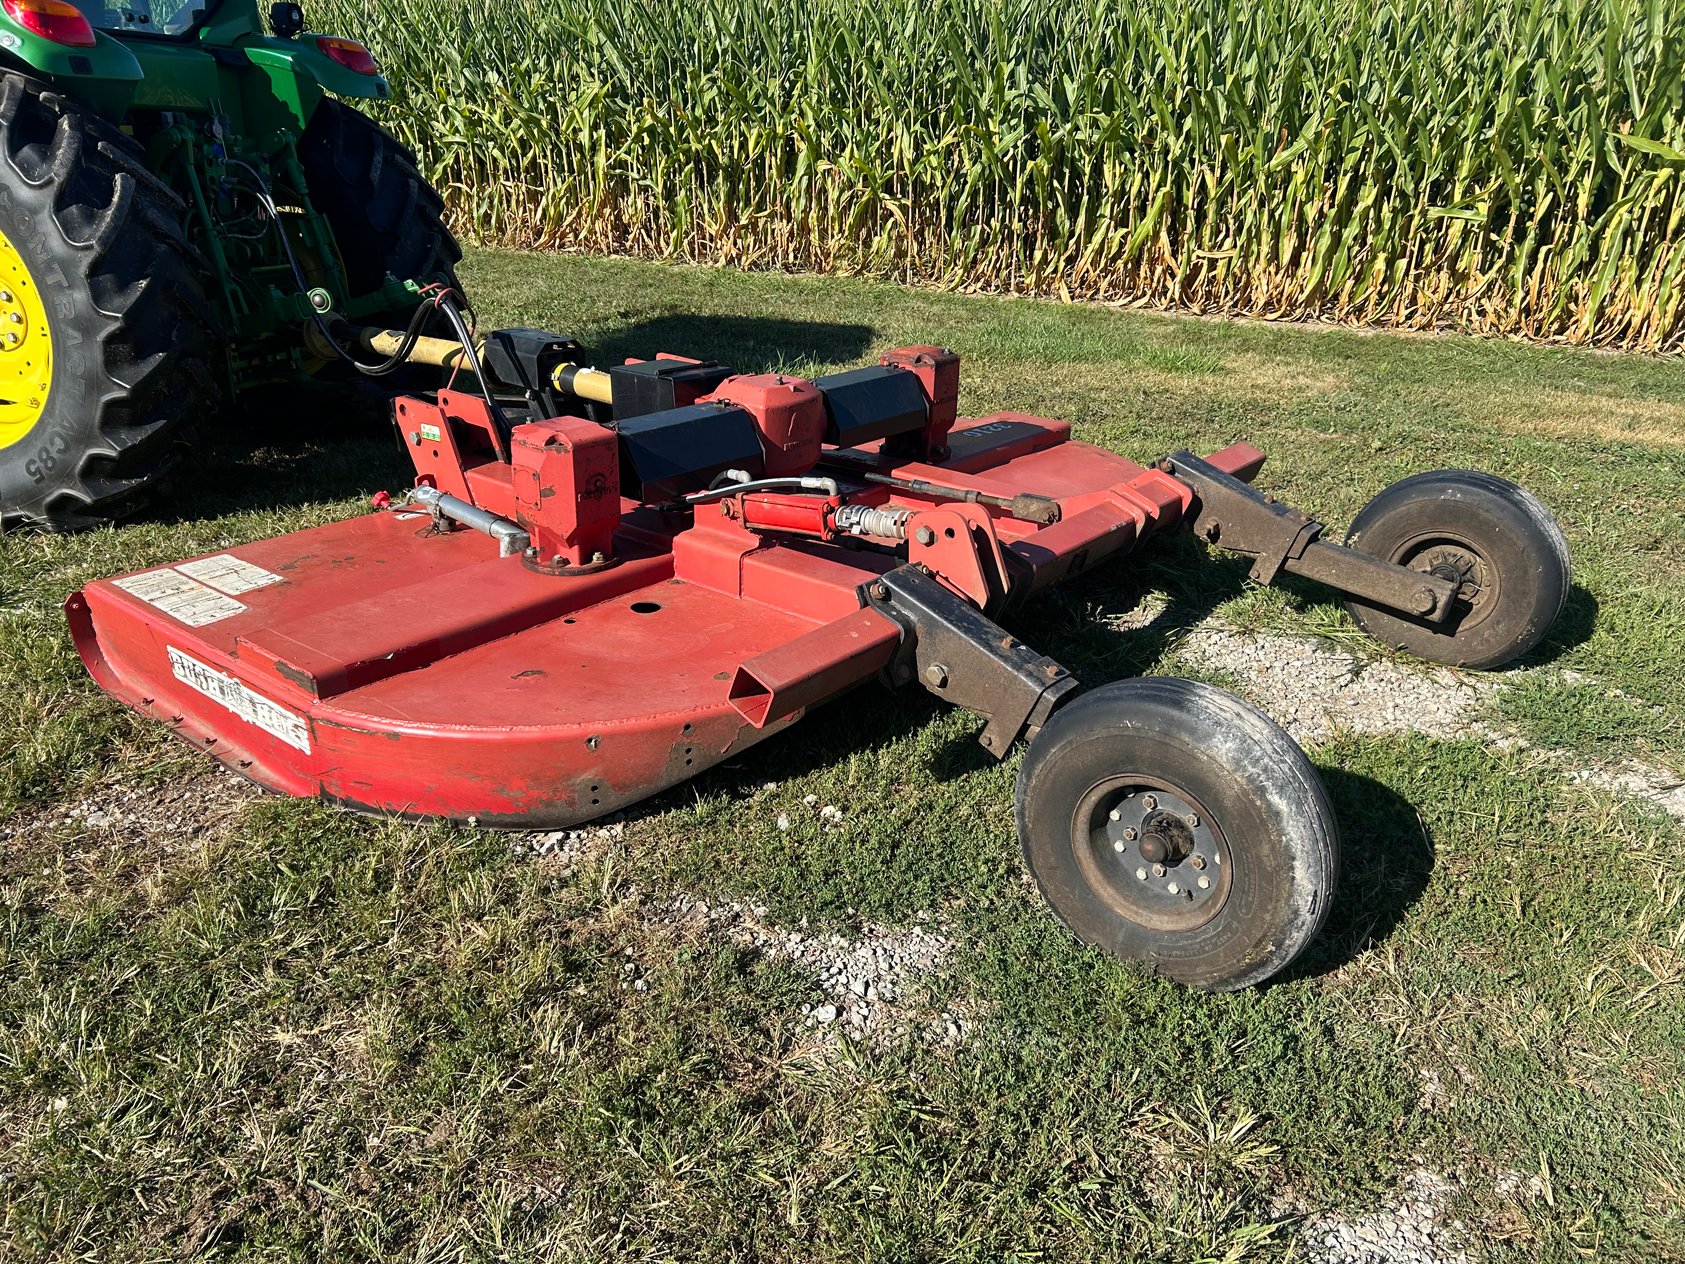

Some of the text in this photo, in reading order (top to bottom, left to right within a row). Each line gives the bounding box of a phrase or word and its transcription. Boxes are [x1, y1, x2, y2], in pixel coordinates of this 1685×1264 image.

[25, 410, 78, 485] AC85
[963, 423, 1012, 437] 3210
[170, 651, 220, 697] BUSH
